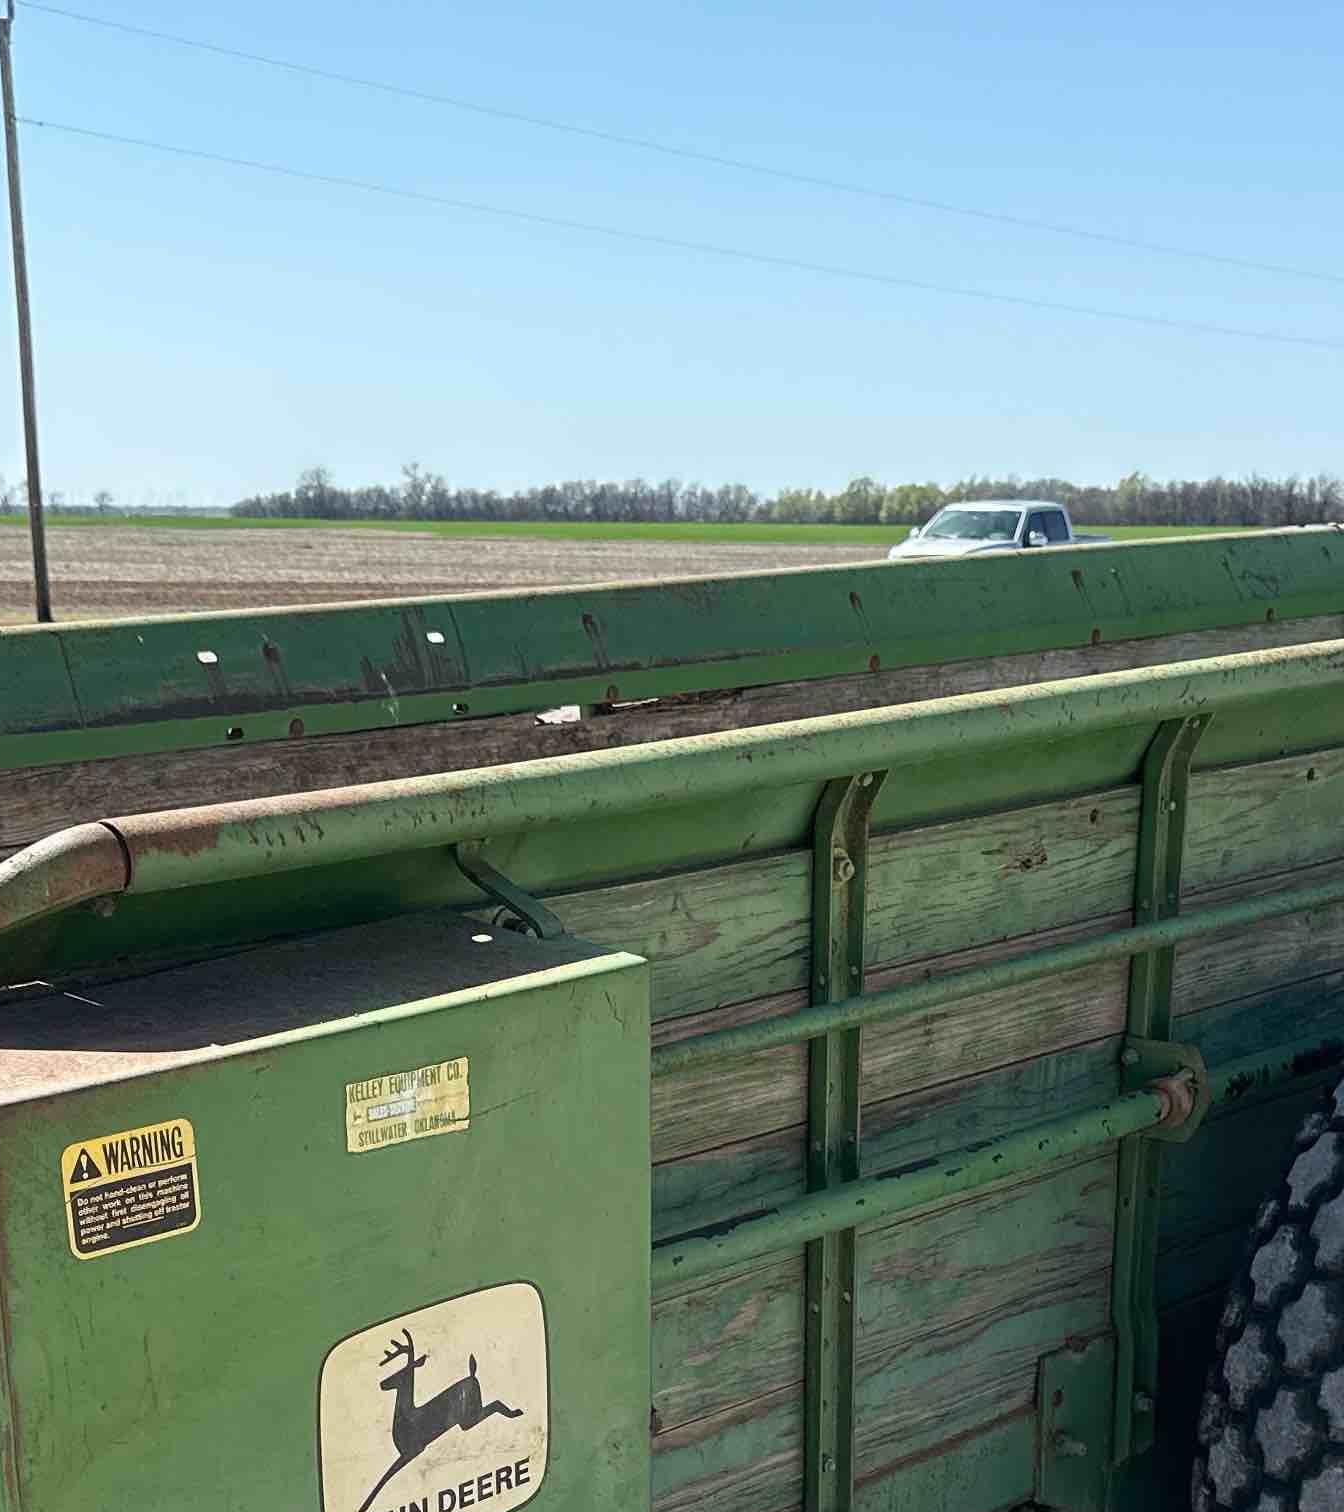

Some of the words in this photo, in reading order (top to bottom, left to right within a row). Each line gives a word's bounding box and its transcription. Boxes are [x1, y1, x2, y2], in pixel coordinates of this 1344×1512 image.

[348, 1078, 386, 1103] KELLEY
[389, 1065, 442, 1095] EQUIPMENT
[446, 1061, 464, 1081] CO.
[102, 1126, 184, 1175] WARNING
[358, 1122, 408, 1147] STILLWATER
[102, 1199, 122, 1210] work
